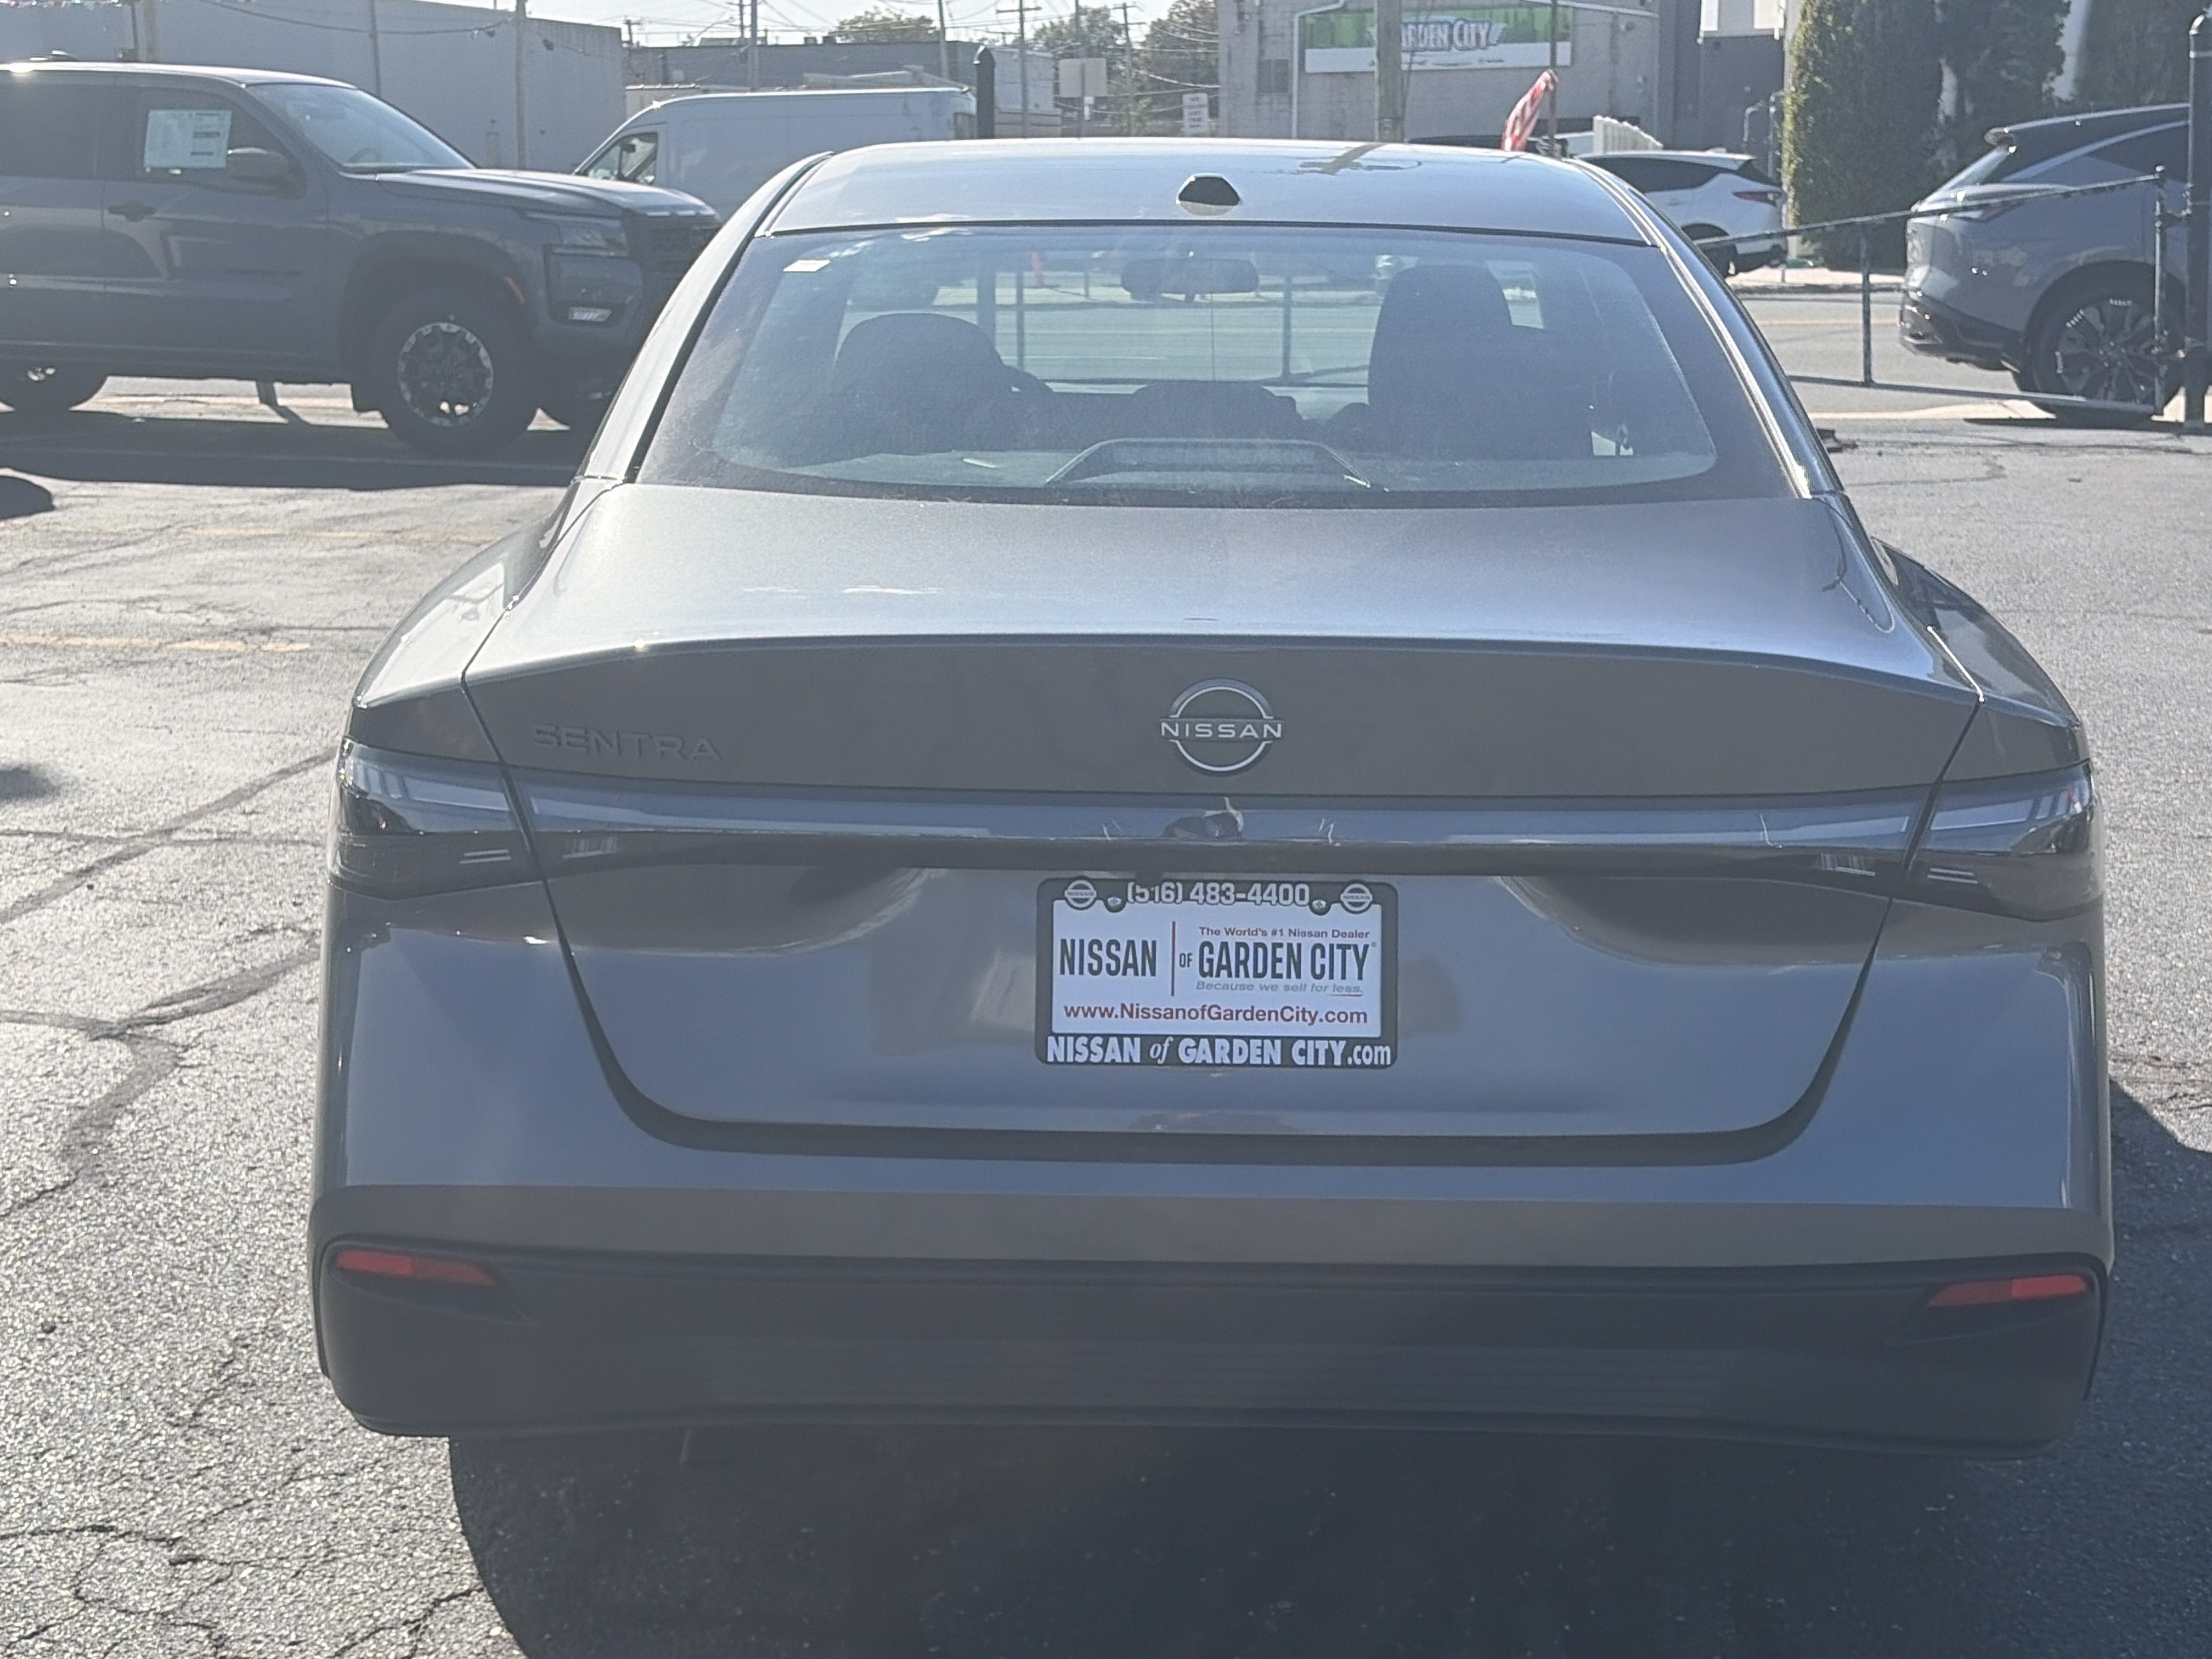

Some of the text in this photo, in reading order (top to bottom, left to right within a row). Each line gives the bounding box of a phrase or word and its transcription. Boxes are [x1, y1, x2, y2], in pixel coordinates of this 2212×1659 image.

[1454, 18, 1491, 50] CITY
[1161, 722, 1282, 738] NISSAN
[533, 724, 723, 761] SENTRA
[1127, 881, 1310, 905] (516) 483-4400
[1199, 927, 1370, 939] The World's #1 Nissan Dealer
[1059, 938, 1370, 981] NISSAN OF GARDEN CITY
[1196, 981, 1363, 994] Because we sell for less.
[1063, 1003, 1368, 1026] www.NissanofGardenCity.com
[1047, 1036, 1141, 1063] NISSAN
[1149, 1036, 1174, 1065] of
[1178, 1037, 1282, 1065] GARDEN
